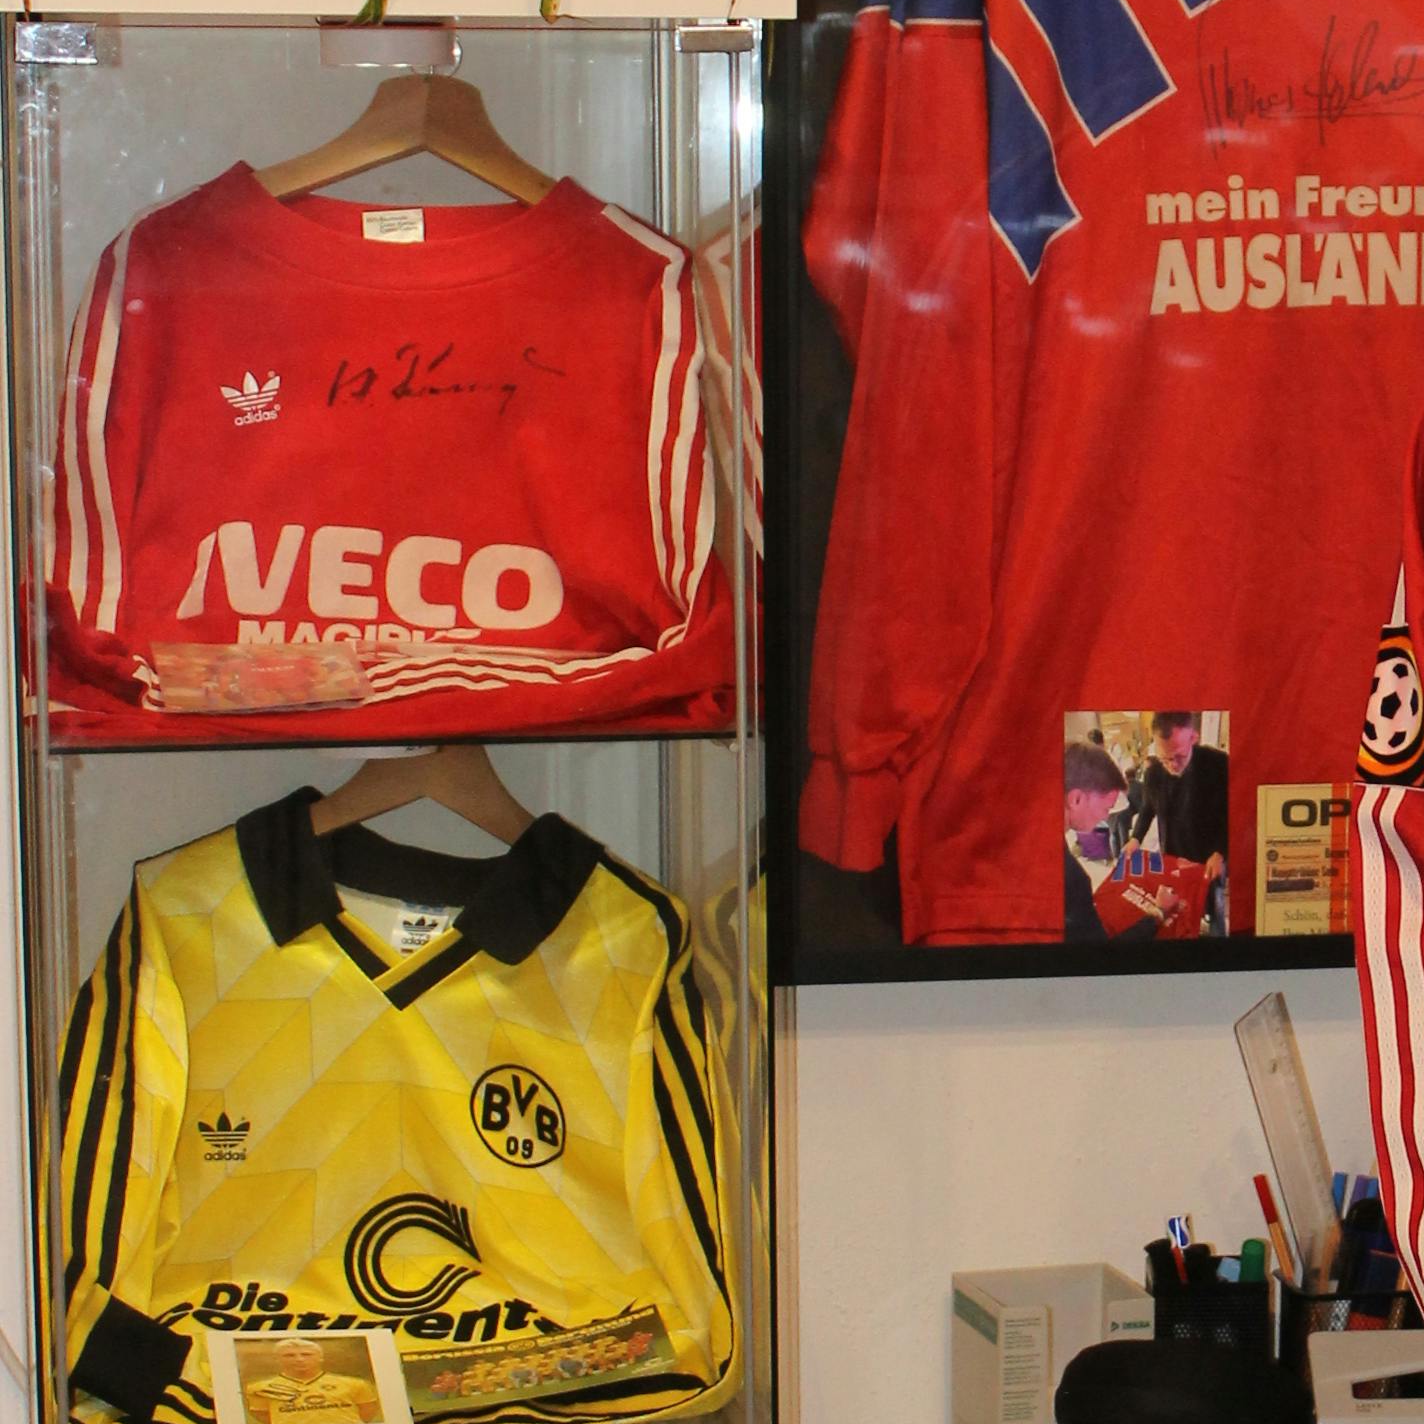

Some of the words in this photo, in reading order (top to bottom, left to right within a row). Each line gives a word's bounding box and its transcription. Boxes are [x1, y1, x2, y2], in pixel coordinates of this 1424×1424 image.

[1145, 174, 1281, 225] mein
[233, 408, 279, 427] adidas
[176, 520, 566, 631] IVECO
[480, 1073, 560, 1148] BVB
[203, 1149, 247, 1162] adidas
[505, 1135, 534, 1159] 09
[203, 1281, 289, 1314] Die
